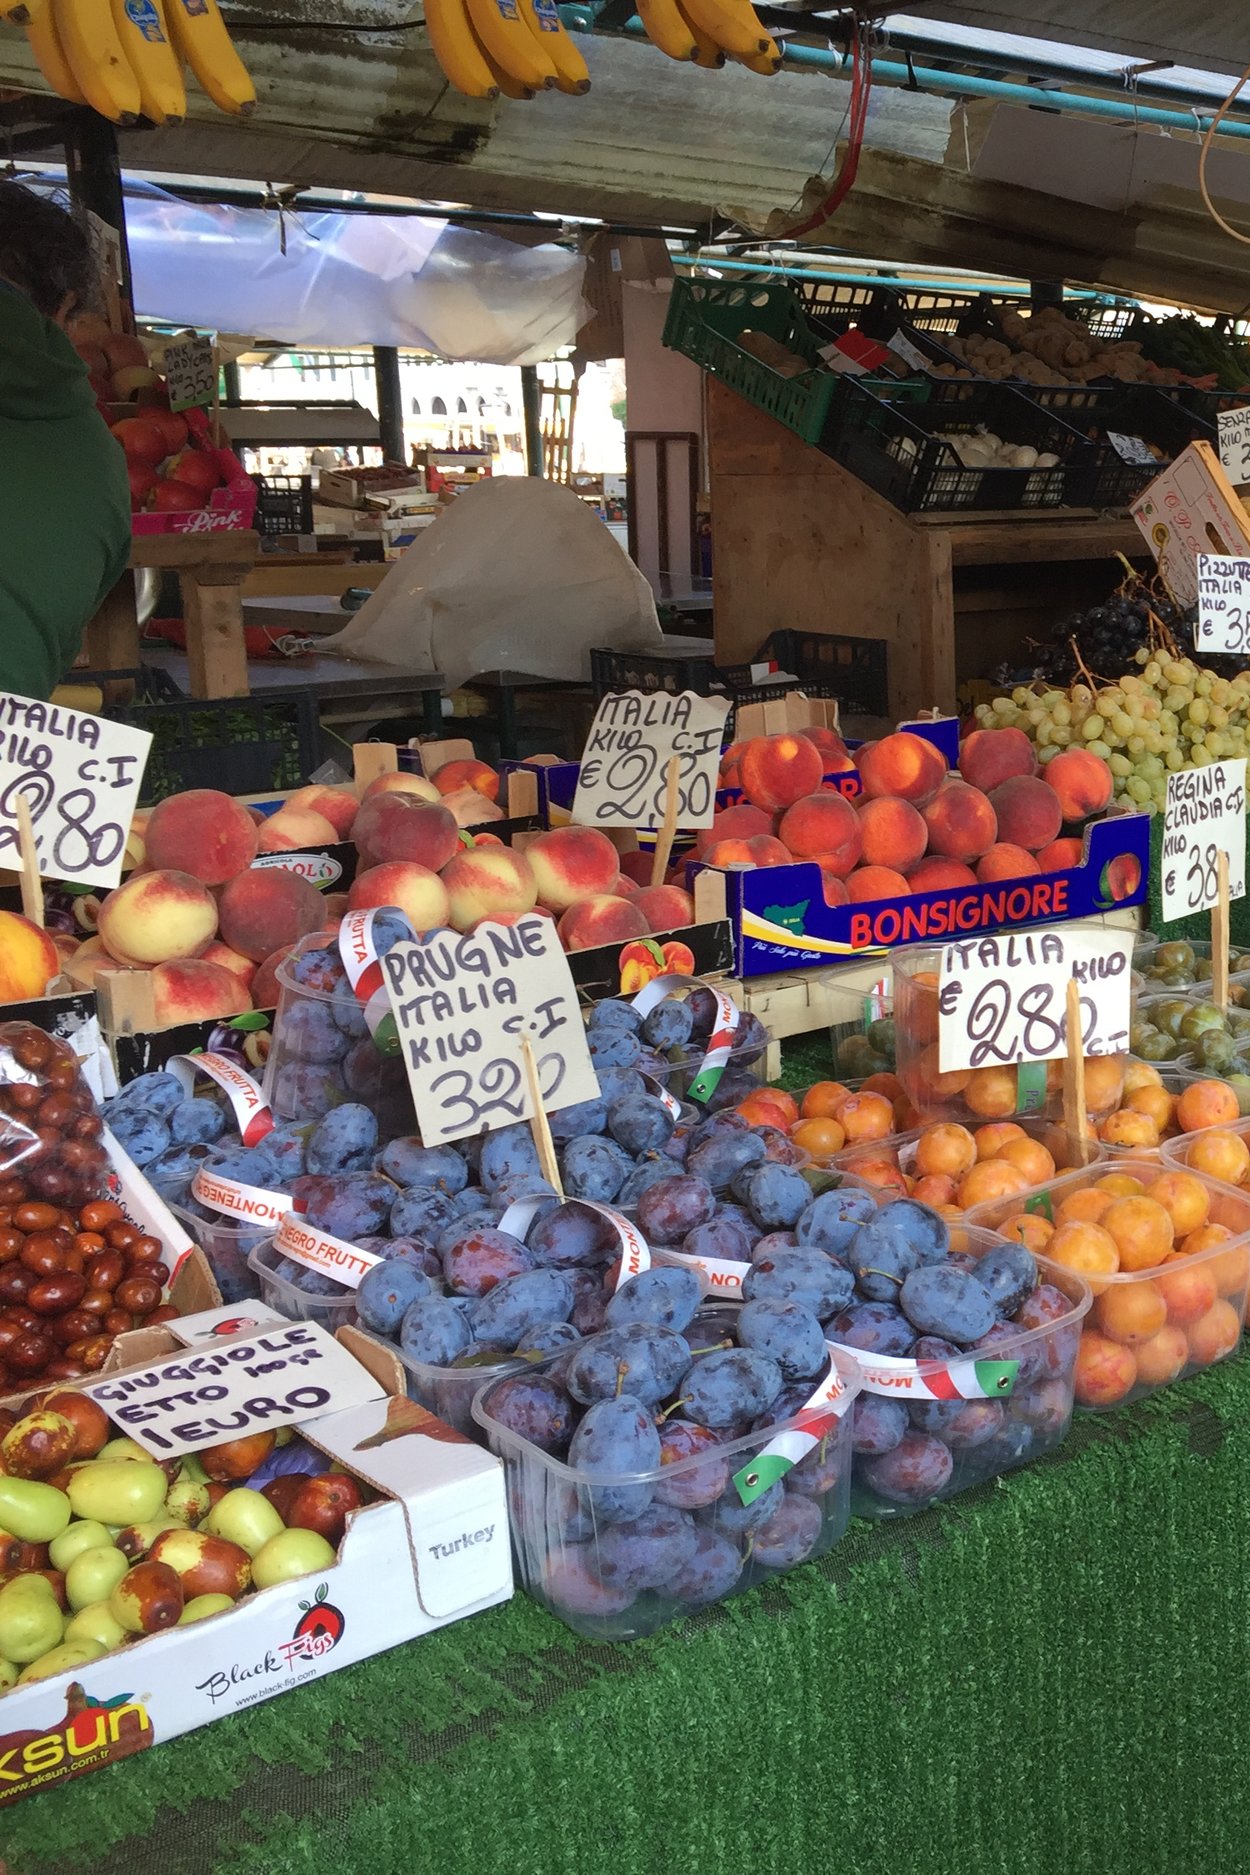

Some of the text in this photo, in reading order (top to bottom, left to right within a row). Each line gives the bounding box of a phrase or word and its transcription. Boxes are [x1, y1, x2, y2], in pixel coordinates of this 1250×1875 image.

[1220, 430, 1242, 448] KILO
[1221, 453, 1231, 467] €
[1199, 578, 1242, 596] ITALIA
[1201, 597, 1227, 611] KILO
[1202, 619, 1214, 637] €
[0, 697, 101, 750] ITALIA
[600, 694, 693, 731] ITALIA
[588, 728, 643, 752] KILO
[579, 743, 711, 828] € 2,80
[1168, 765, 1227, 806] REGINA
[1163, 796, 1223, 833] CLAUDIA
[1162, 833, 1187, 860] KILO
[1164, 869, 1176, 896] €
[851, 880, 1070, 950] BONSIGNORE
[384, 919, 547, 997] PRUGNE
[946, 933, 1127, 985] ITALIA KILO
[398, 976, 518, 1029] ITALIA
[940, 978, 1098, 1068] € 2,80
[408, 1027, 483, 1070] KILO
[92, 1328, 317, 1402] GIUGGIOLE
[115, 1385, 230, 1425] ETTO
[140, 1386, 332, 1449] 1 EURO
[428, 1523, 497, 1561] Turkey
[195, 1629, 336, 1705] Black Figs
[235, 1667, 318, 1707] www.black-fig.com
